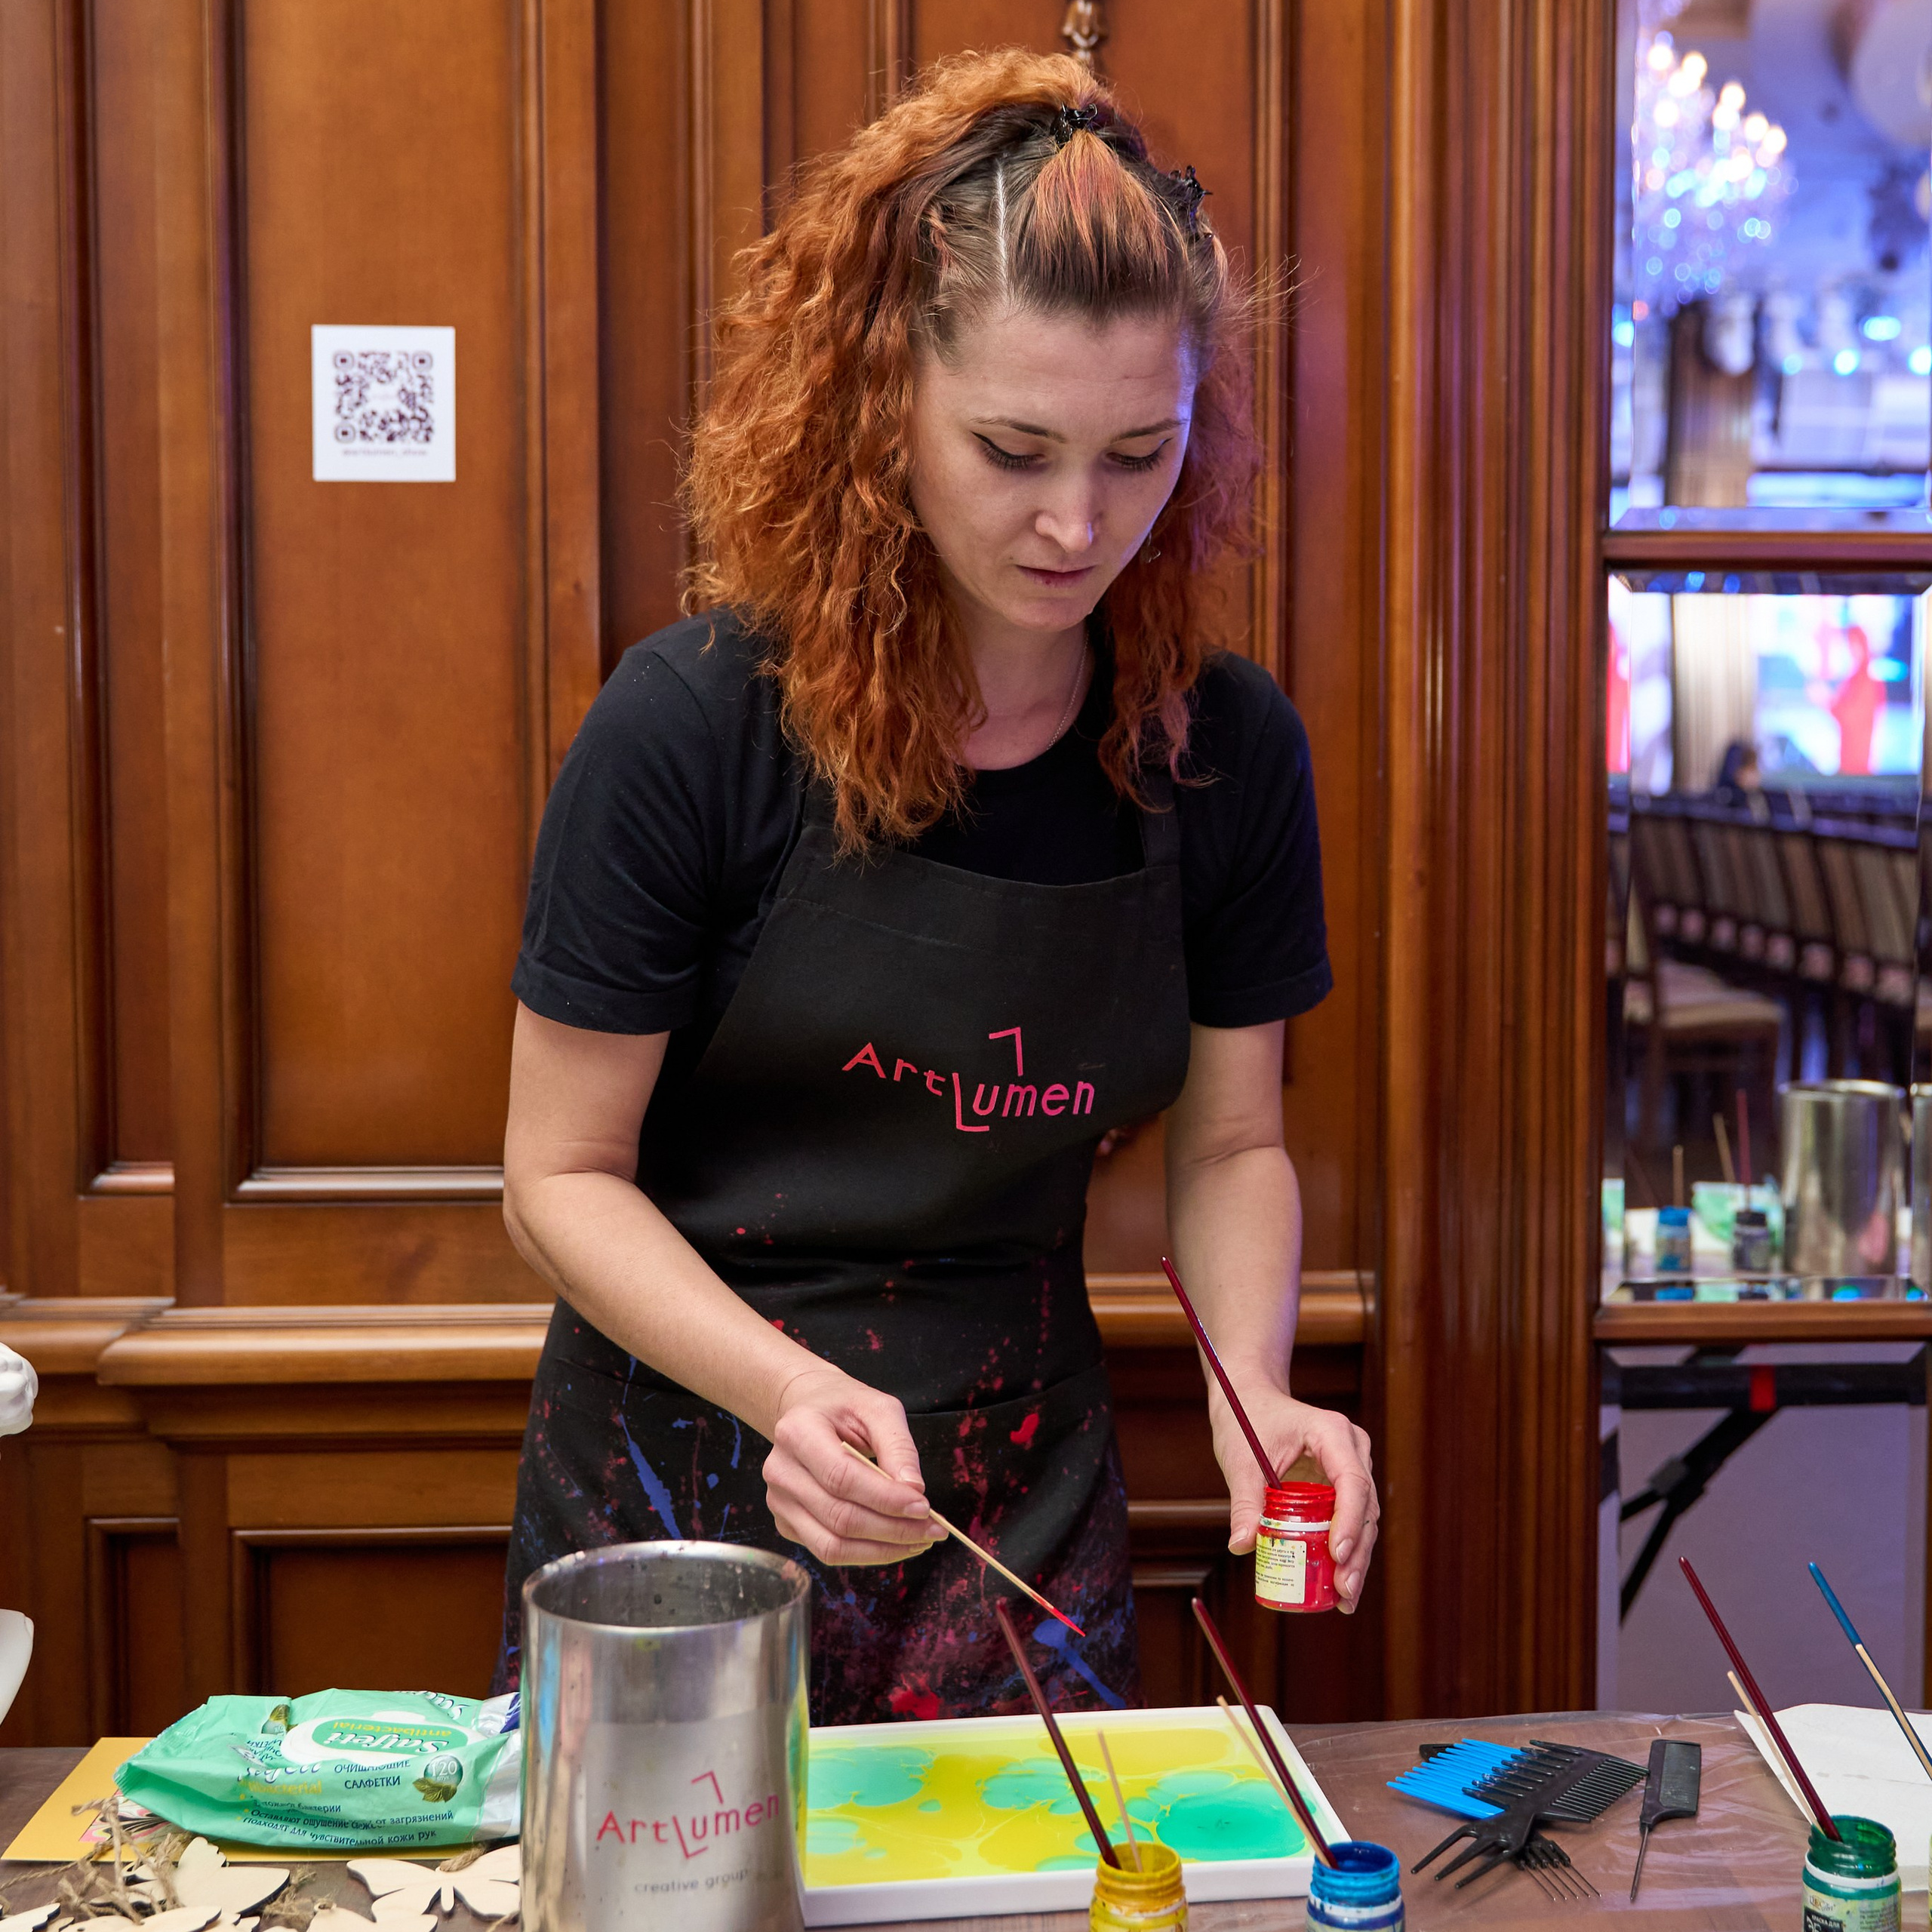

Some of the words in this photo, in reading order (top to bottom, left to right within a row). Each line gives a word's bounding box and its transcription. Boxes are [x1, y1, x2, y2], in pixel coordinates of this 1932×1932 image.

[333, 1721, 452, 1737] antibacterial
[323, 1732, 449, 1754] Salfeti
[430, 1760, 457, 1777] 120
[344, 1776, 400, 1789] САЛФЕТКИ
[251, 1809, 300, 1824] Оставляют
[390, 1810, 453, 1826] загрязнений
[291, 1827, 307, 1837] для
[388, 1833, 414, 1844] кожи
[418, 1829, 436, 1841] рук
[634, 1878, 700, 1894] creative
[705, 1867, 749, 1888] group
